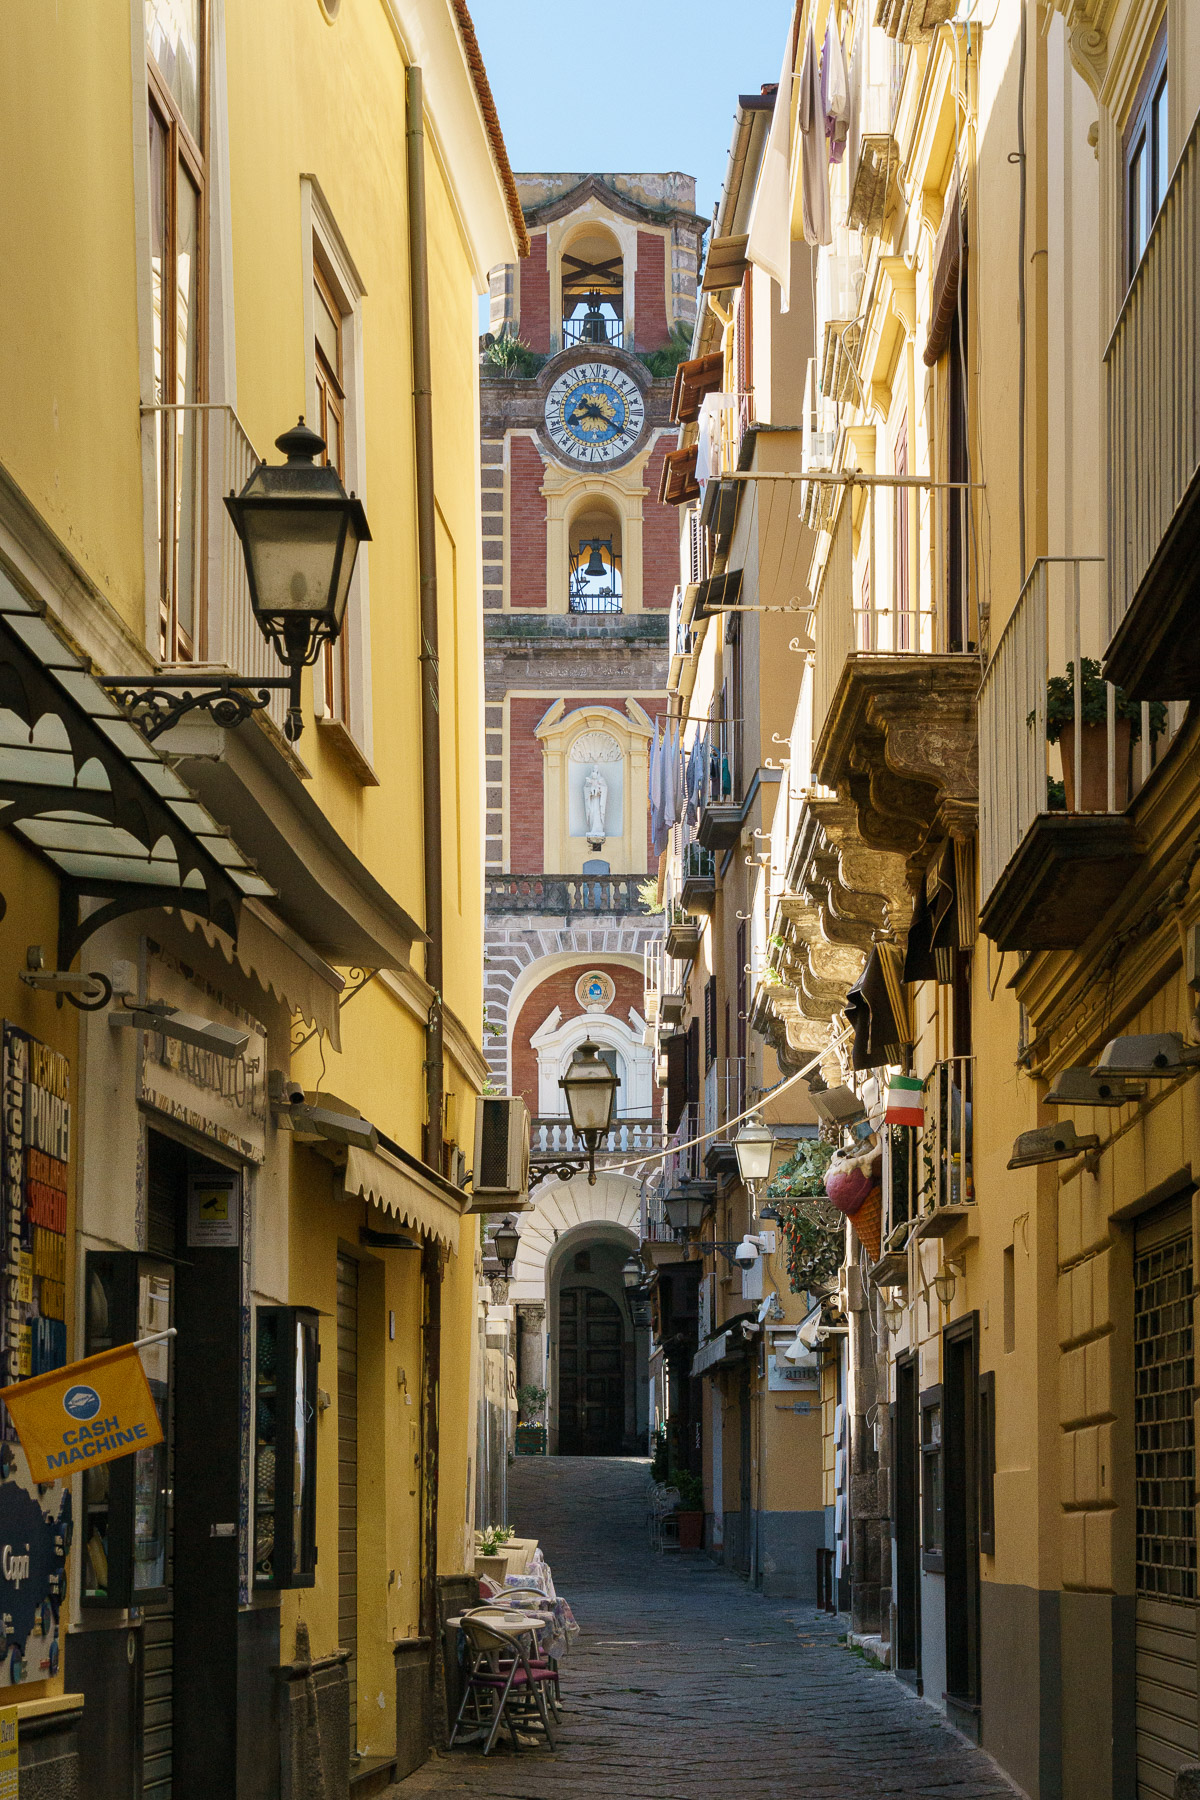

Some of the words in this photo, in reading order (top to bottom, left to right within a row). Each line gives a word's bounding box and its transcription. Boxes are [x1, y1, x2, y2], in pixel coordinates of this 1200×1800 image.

[30, 1083, 71, 1163] POMPEI
[46, 1423, 149, 1470] MACHINE
[62, 1415, 120, 1446] CASH
[2, 1543, 31, 1590] Capri
